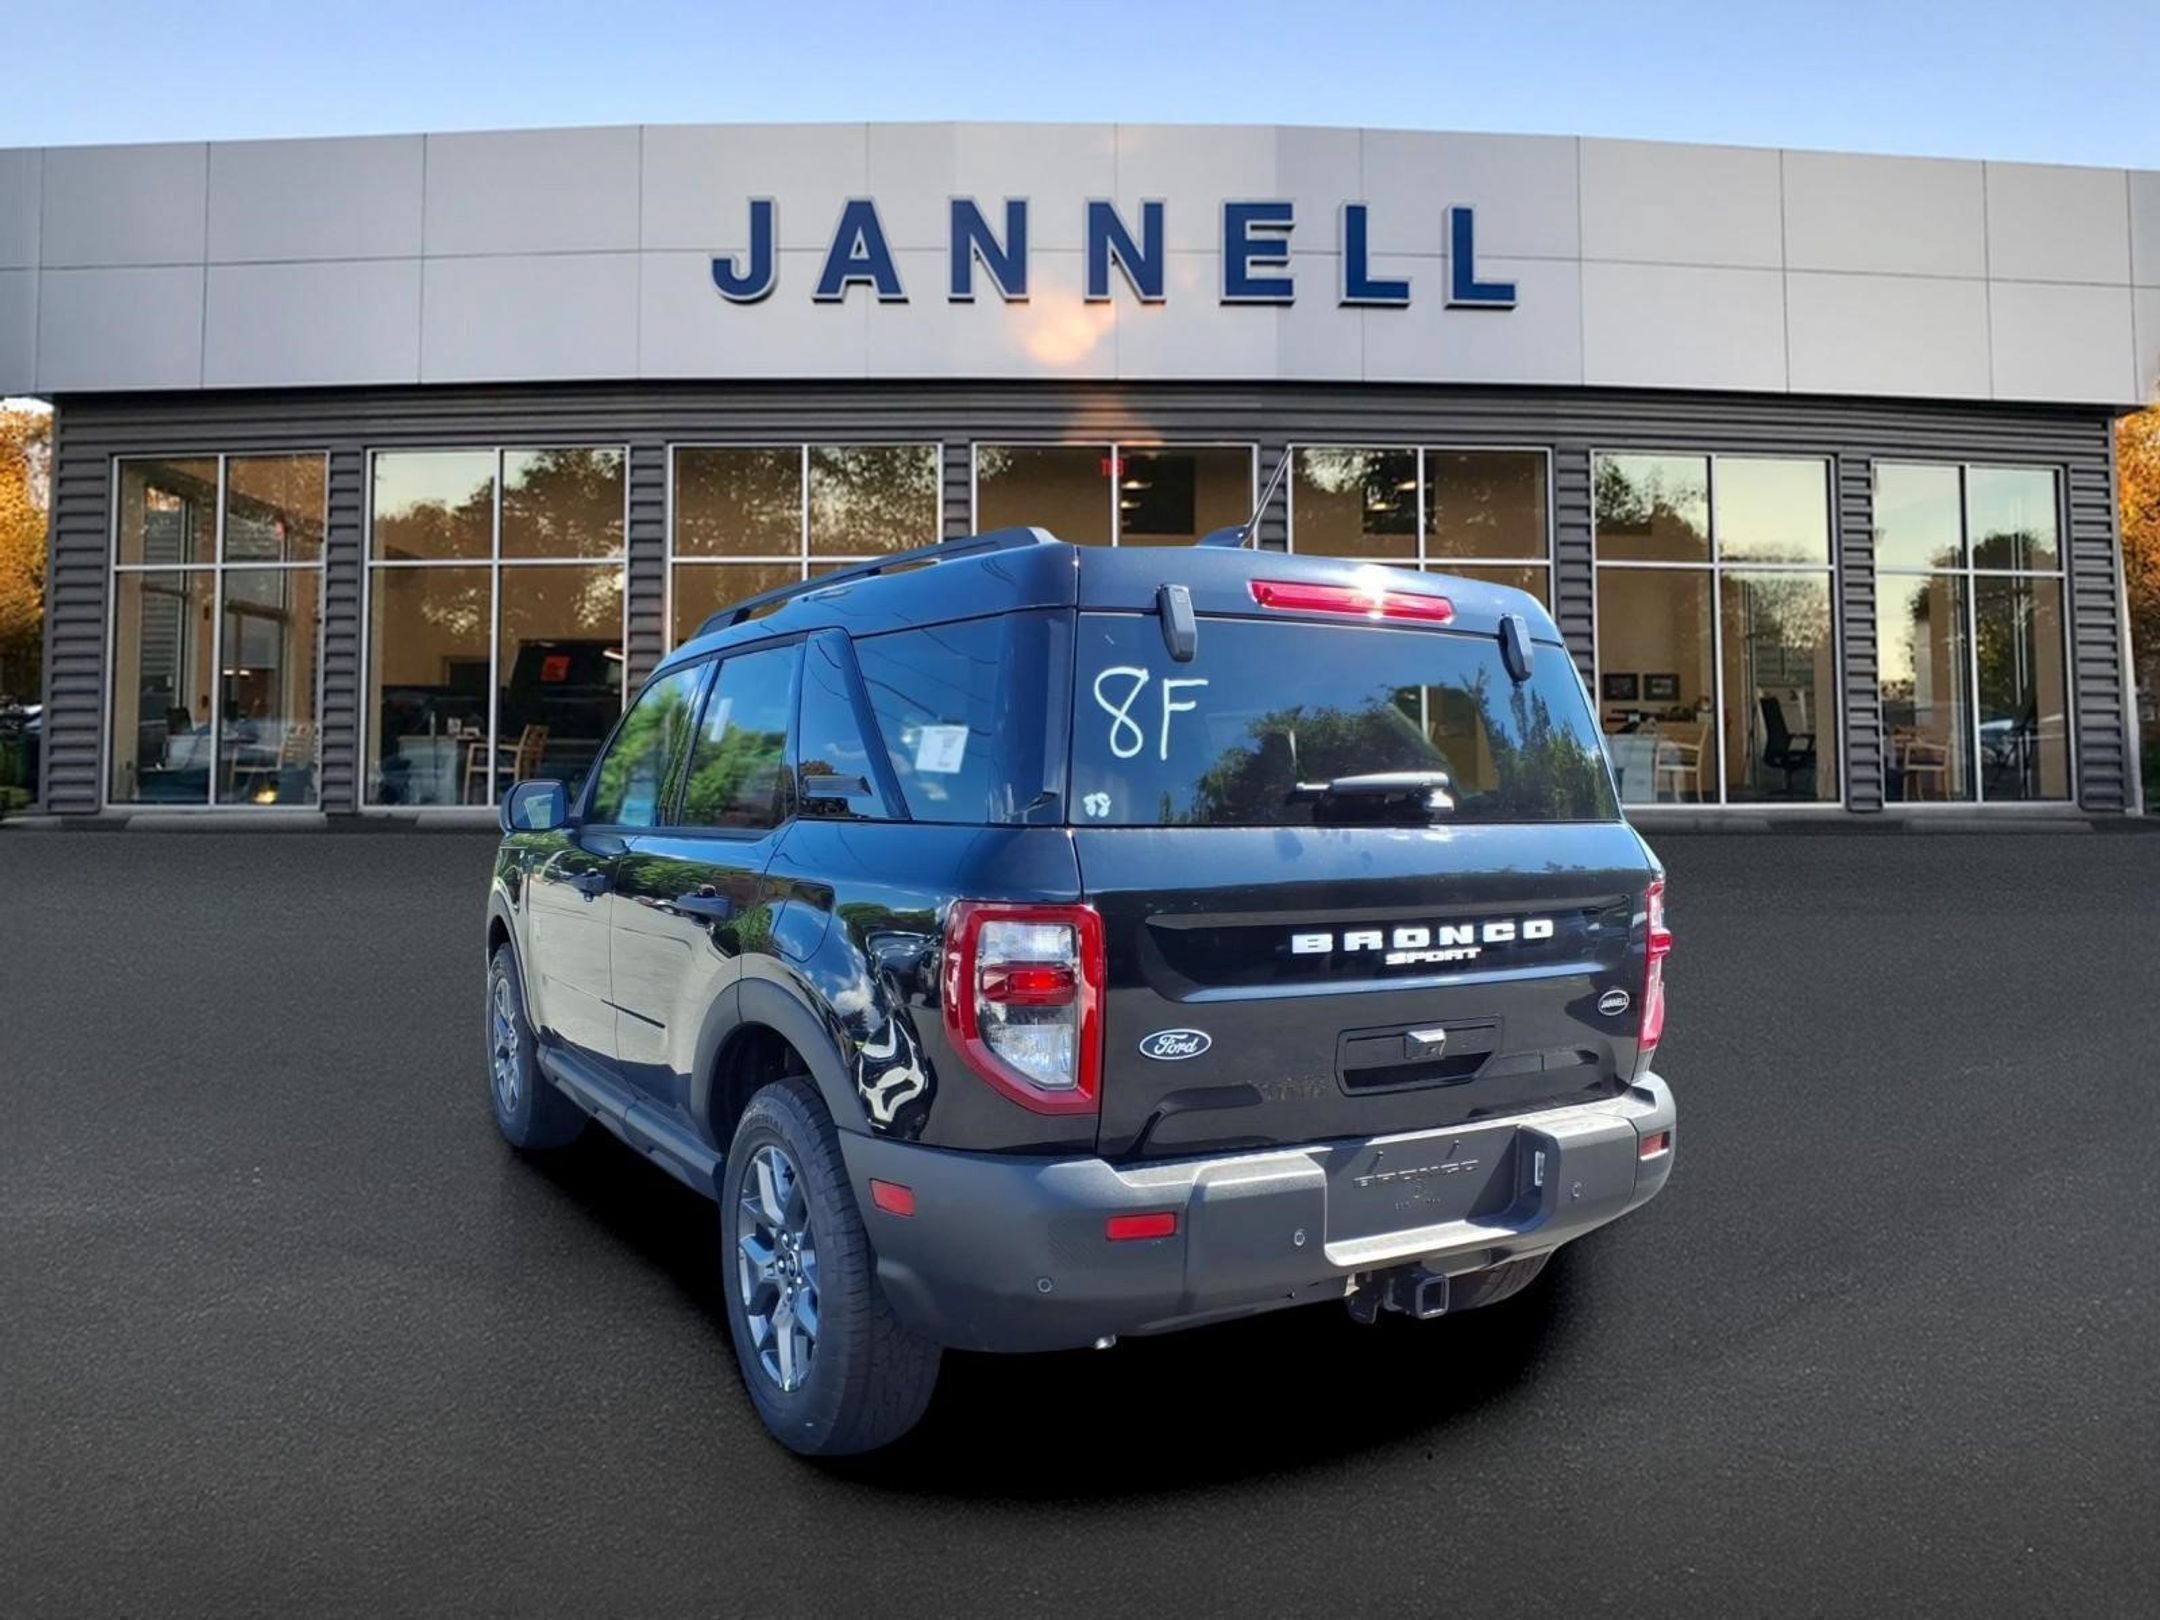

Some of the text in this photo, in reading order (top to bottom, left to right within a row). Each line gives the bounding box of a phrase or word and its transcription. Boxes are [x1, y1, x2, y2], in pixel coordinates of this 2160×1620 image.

[711, 195, 1517, 308] JANNELL
[1093, 666, 1208, 761] 8F
[1291, 919, 1553, 954] BRONCO
[1385, 946, 1482, 966] SPORT
[1154, 1033, 1198, 1056] Ford
